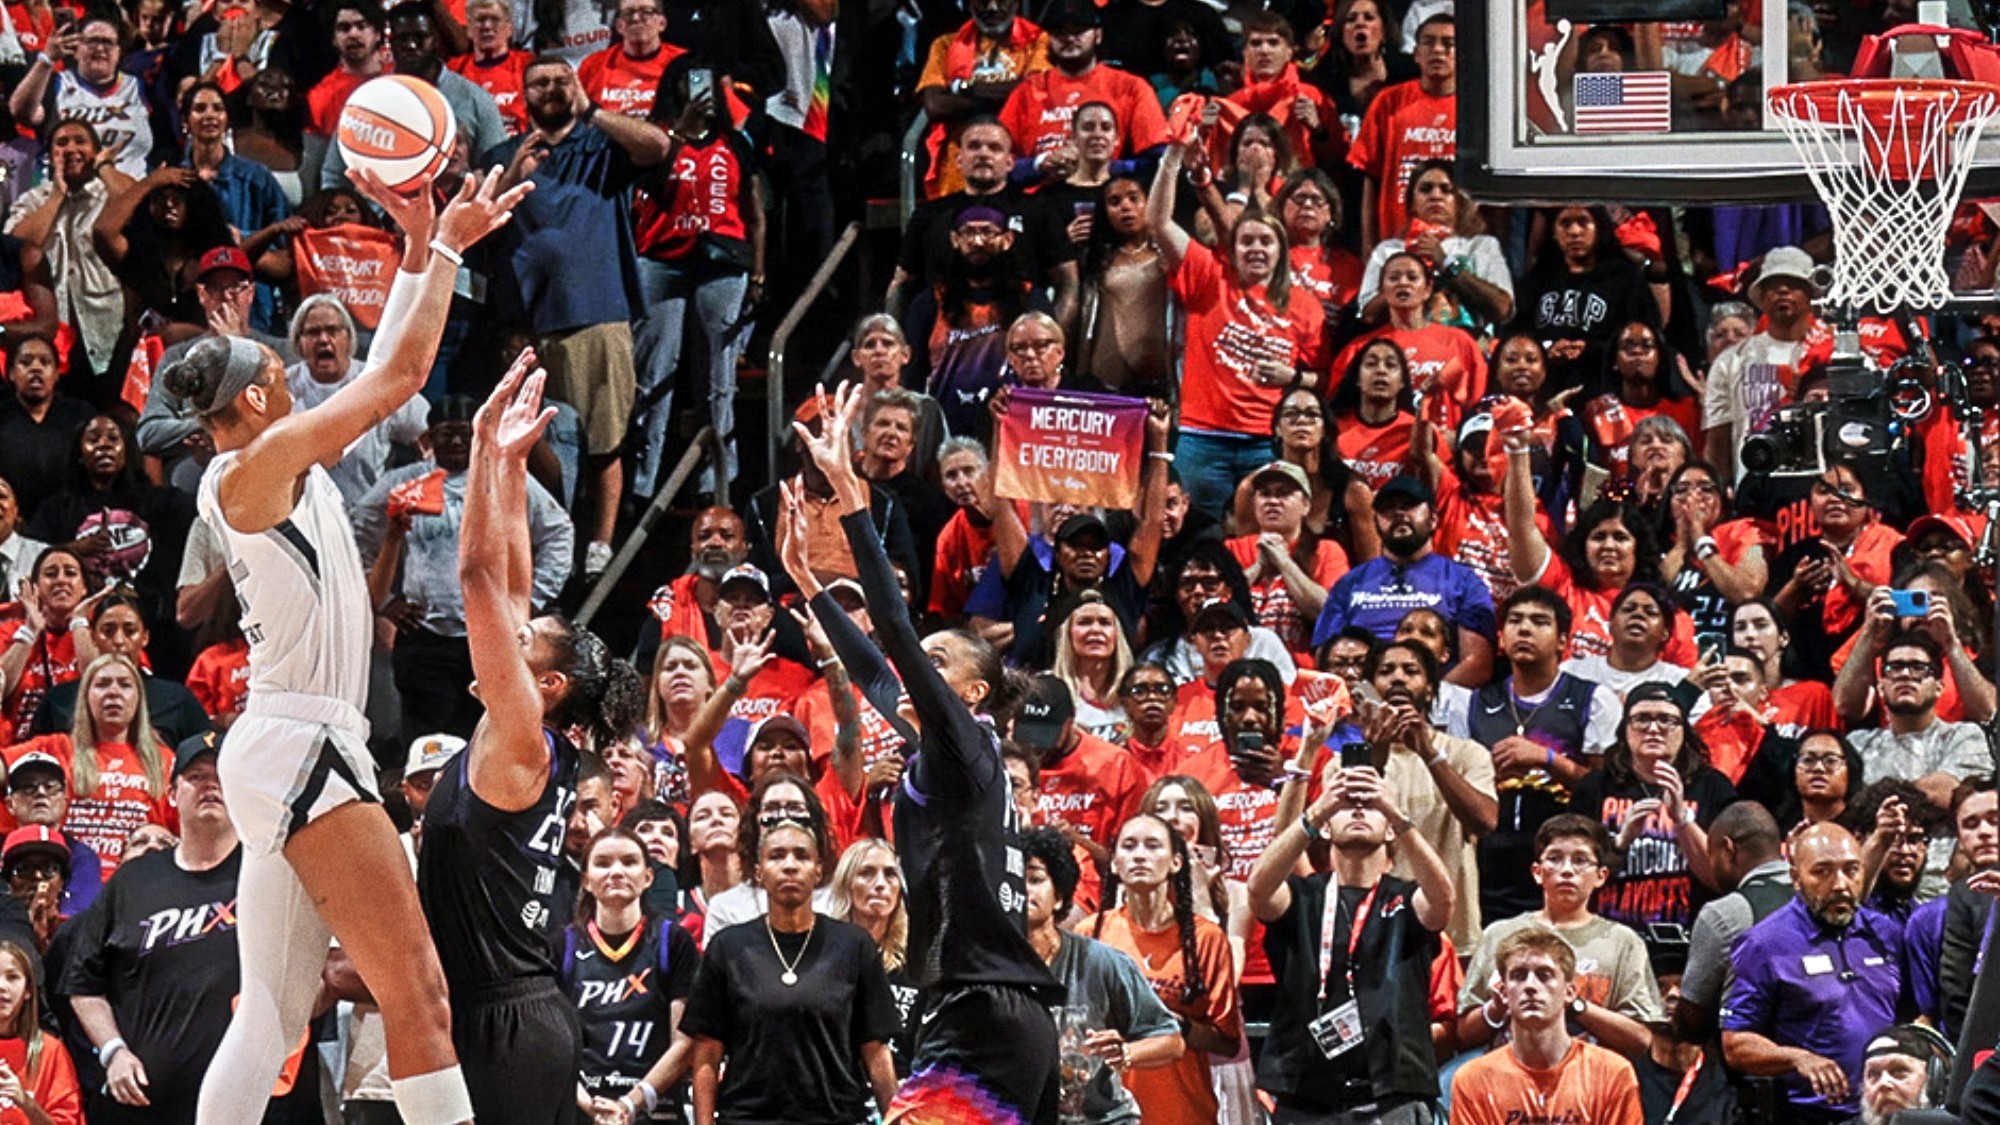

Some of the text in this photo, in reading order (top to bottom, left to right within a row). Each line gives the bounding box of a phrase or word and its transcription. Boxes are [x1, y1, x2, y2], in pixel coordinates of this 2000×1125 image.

[1403, 127, 1456, 142] MERCU
[669, 158, 698, 181] 2
[709, 153, 728, 214] ACES
[1030, 406, 1116, 437] MERCURY
[1018, 442, 1120, 474] EVERYBODY
[1035, 793, 1096, 811] RCURY
[1213, 790, 1282, 810] MERCUR
[139, 898, 237, 955] PHX
[578, 967, 653, 1009] PHX
[606, 1021, 654, 1058] 14
